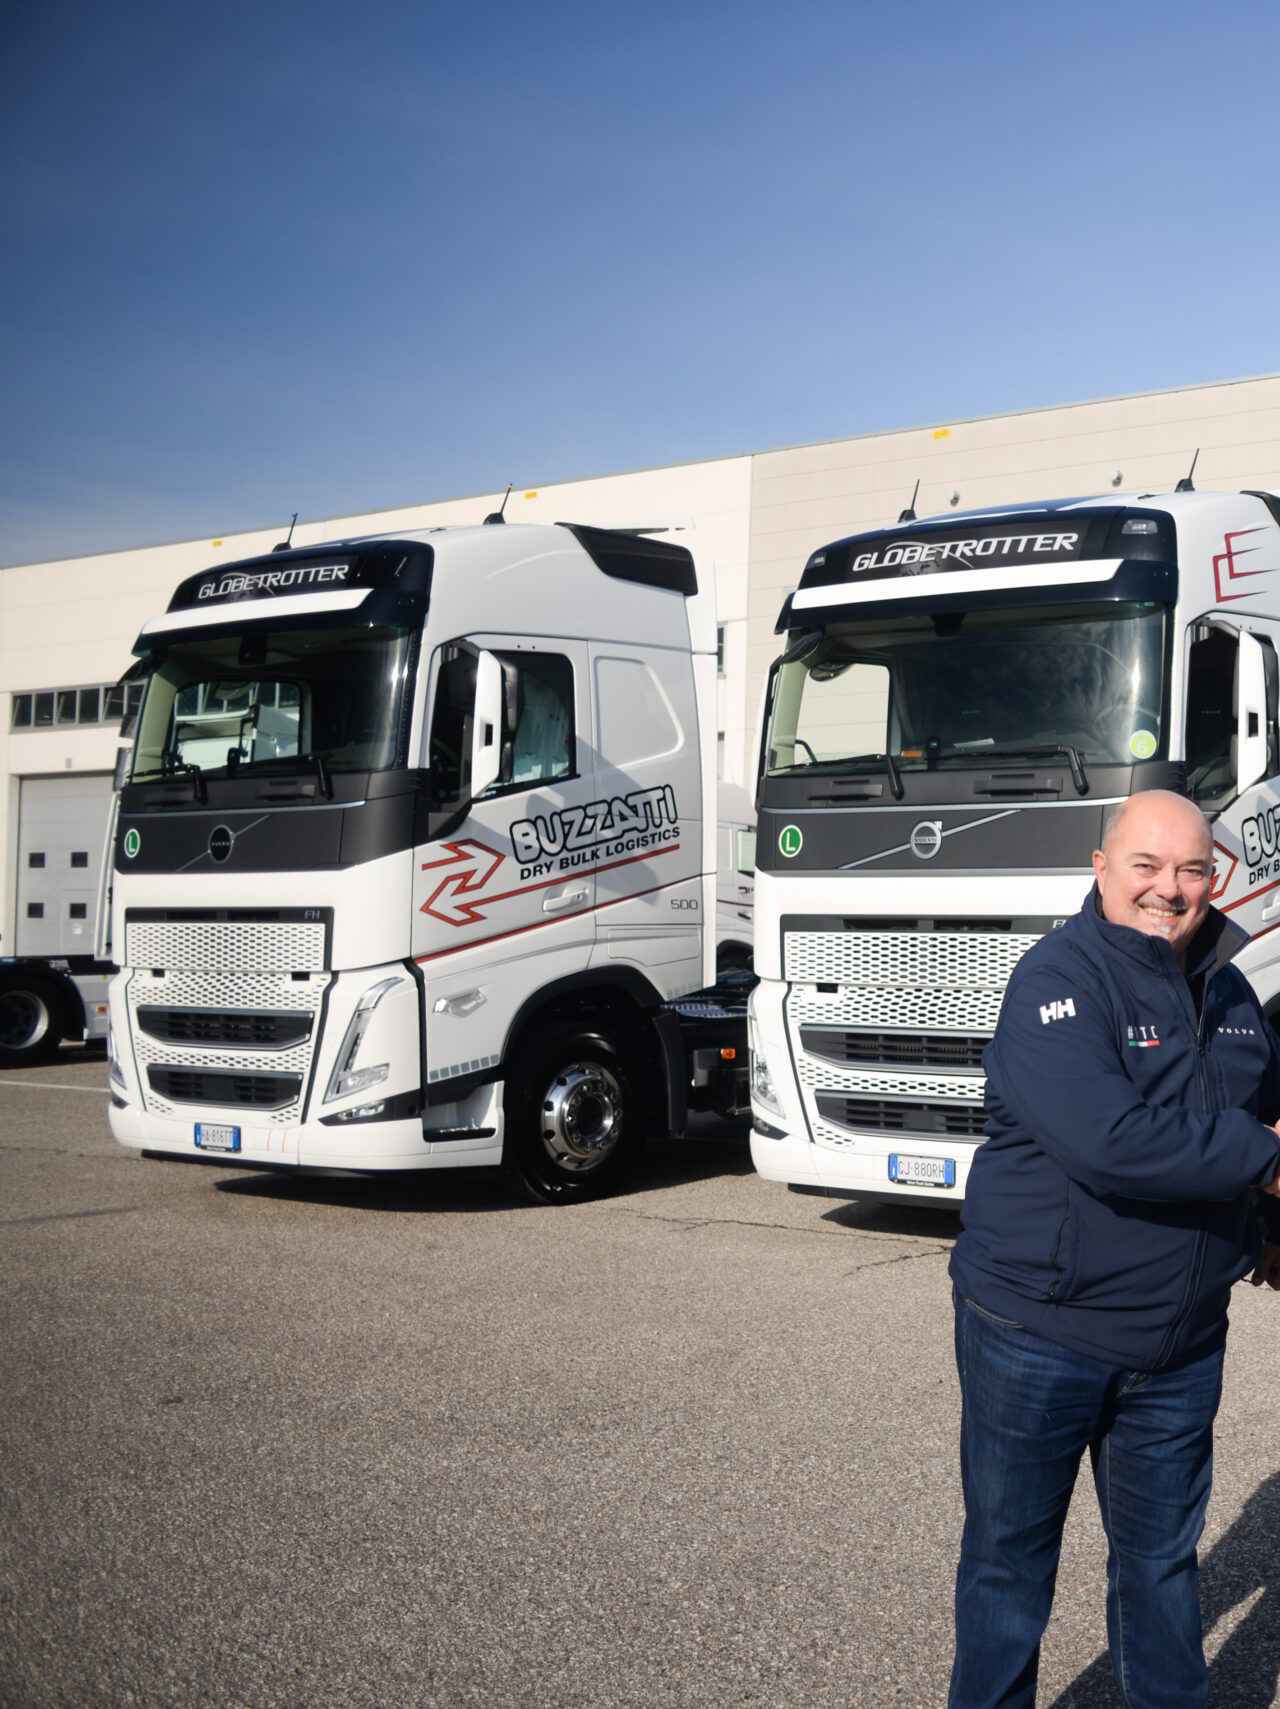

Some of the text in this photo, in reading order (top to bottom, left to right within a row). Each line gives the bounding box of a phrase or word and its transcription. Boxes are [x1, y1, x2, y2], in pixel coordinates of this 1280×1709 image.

[852, 533, 1079, 572] GLOBETROTTER
[198, 565, 349, 599] GLOBETROTTER
[1135, 740, 1150, 754] 6
[510, 784, 678, 864] BUZZATTI
[128, 834, 136, 852] L
[785, 831, 796, 851] L
[520, 827, 680, 880] DRY BULK LOGISTICS
[1249, 864, 1271, 886] DRY
[305, 910, 320, 919] FH
[671, 899, 698, 910] 500
[1217, 1027, 1255, 1035] VOLVO
